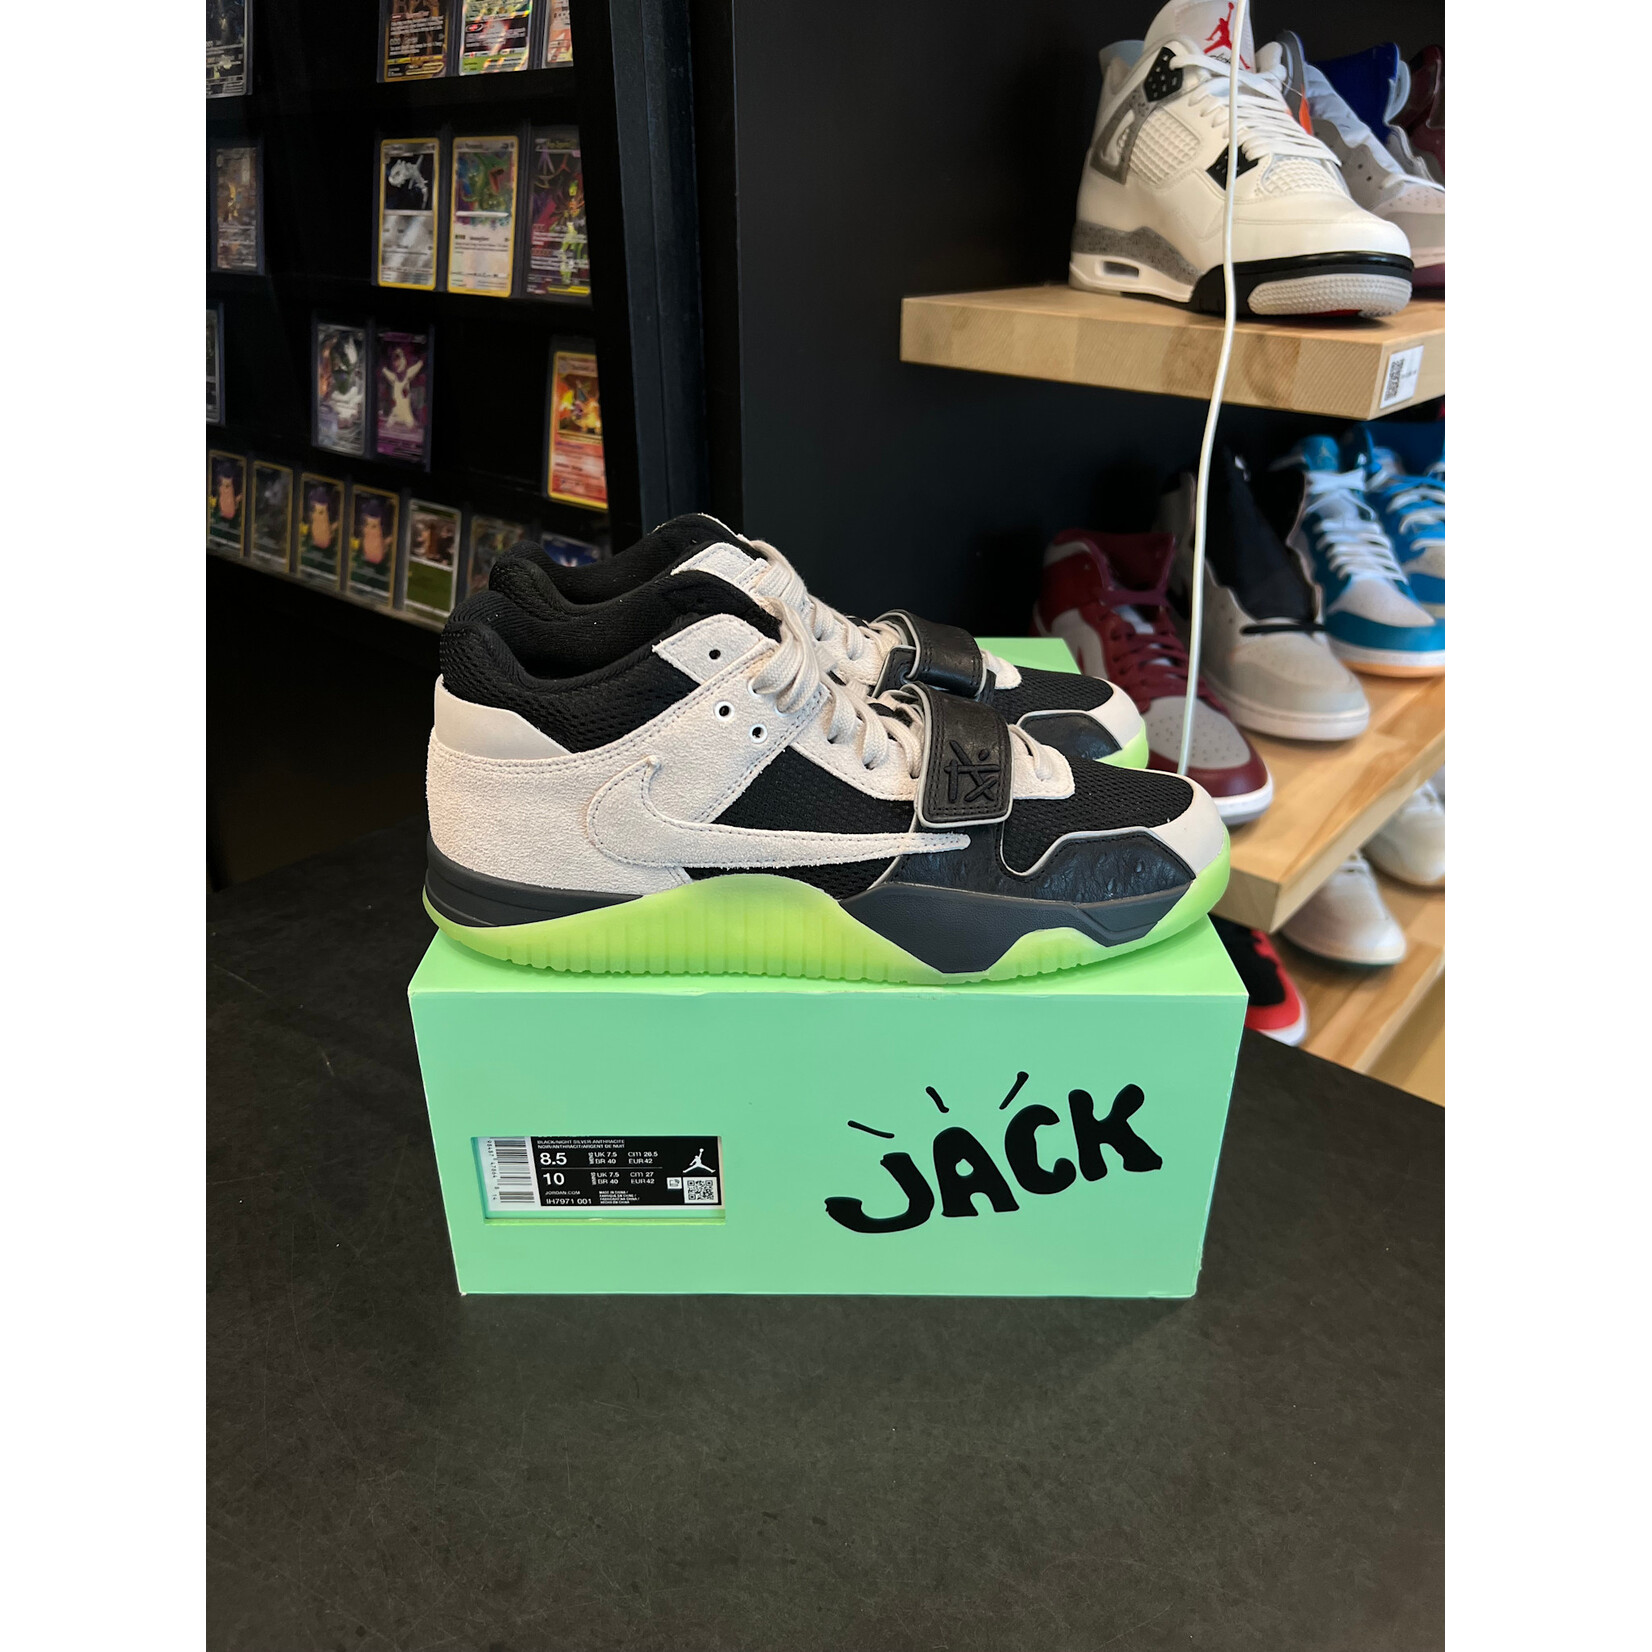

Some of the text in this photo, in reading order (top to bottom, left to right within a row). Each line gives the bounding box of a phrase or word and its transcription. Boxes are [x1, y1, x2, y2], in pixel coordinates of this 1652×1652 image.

[540, 1152, 567, 1165] 8.5
[825, 1083, 1163, 1233] JACK
[542, 1172, 565, 1186] 10
